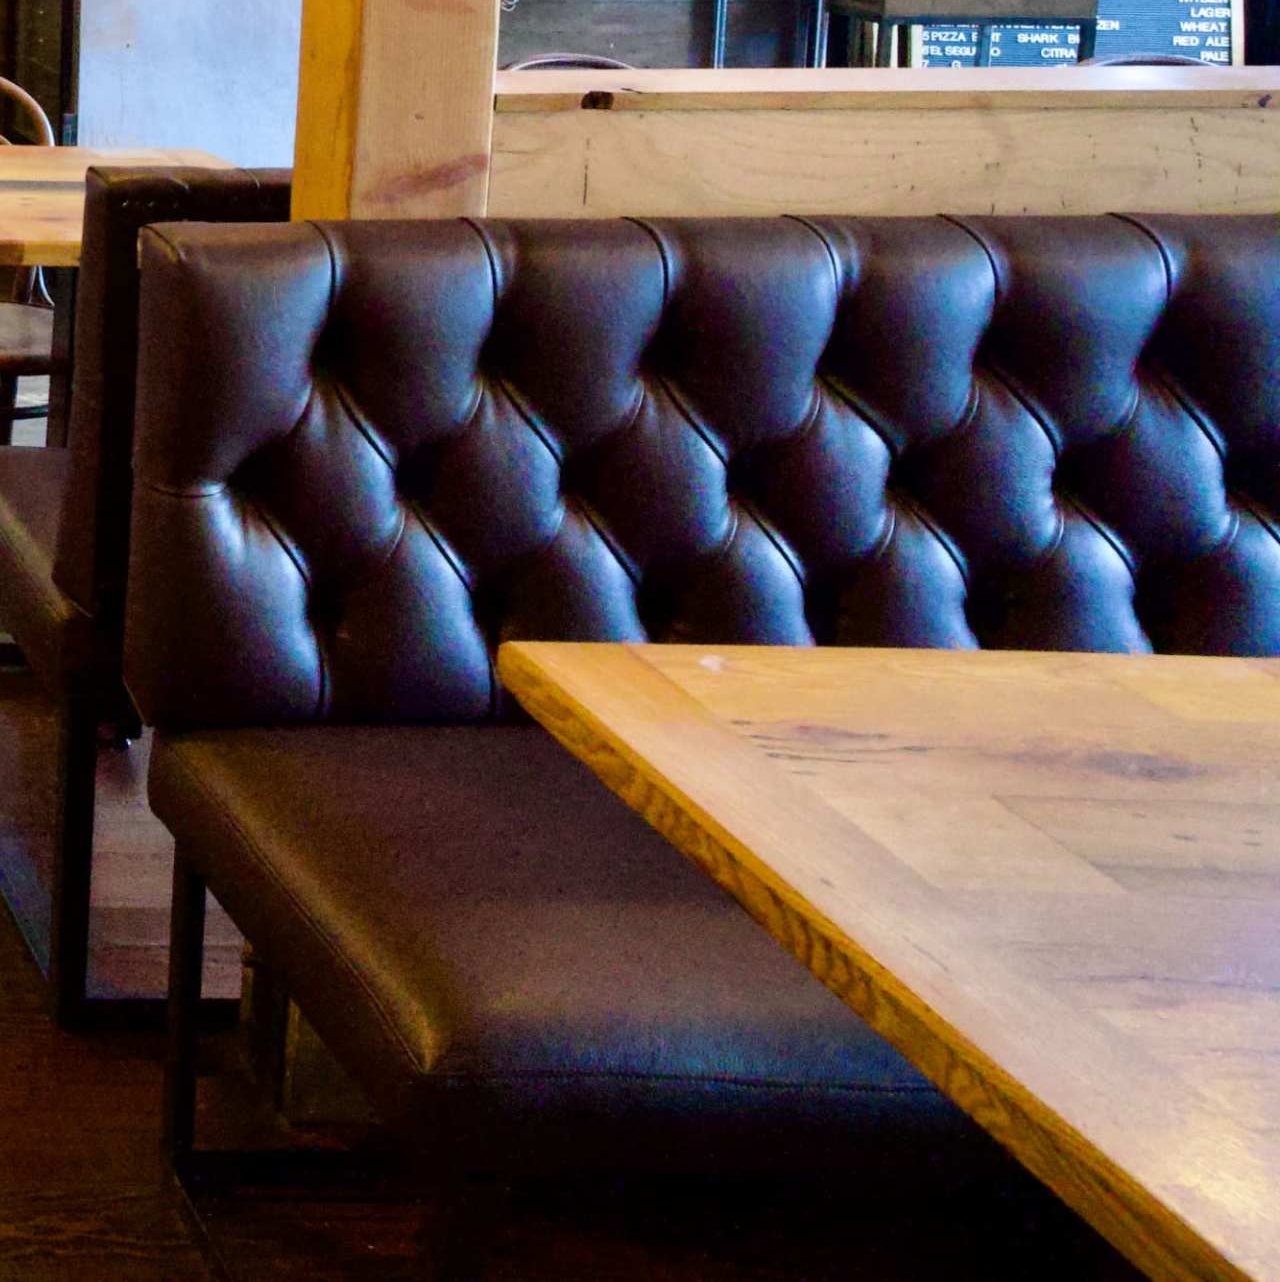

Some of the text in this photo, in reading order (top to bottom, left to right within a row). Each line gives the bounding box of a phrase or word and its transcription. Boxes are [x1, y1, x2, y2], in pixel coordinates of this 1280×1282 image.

[1190, 7, 1231, 18] LAGER
[1096, 19, 1121, 31] ZEN
[1180, 21, 1227, 33] WHEAT
[931, 31, 966, 42] PIZZA
[1017, 32, 1059, 43] SHARK
[1173, 35, 1200, 47] RED
[1205, 35, 1230, 47] ALE
[1040, 46, 1077, 58] CITRA
[1199, 50, 1230, 62] PALE
